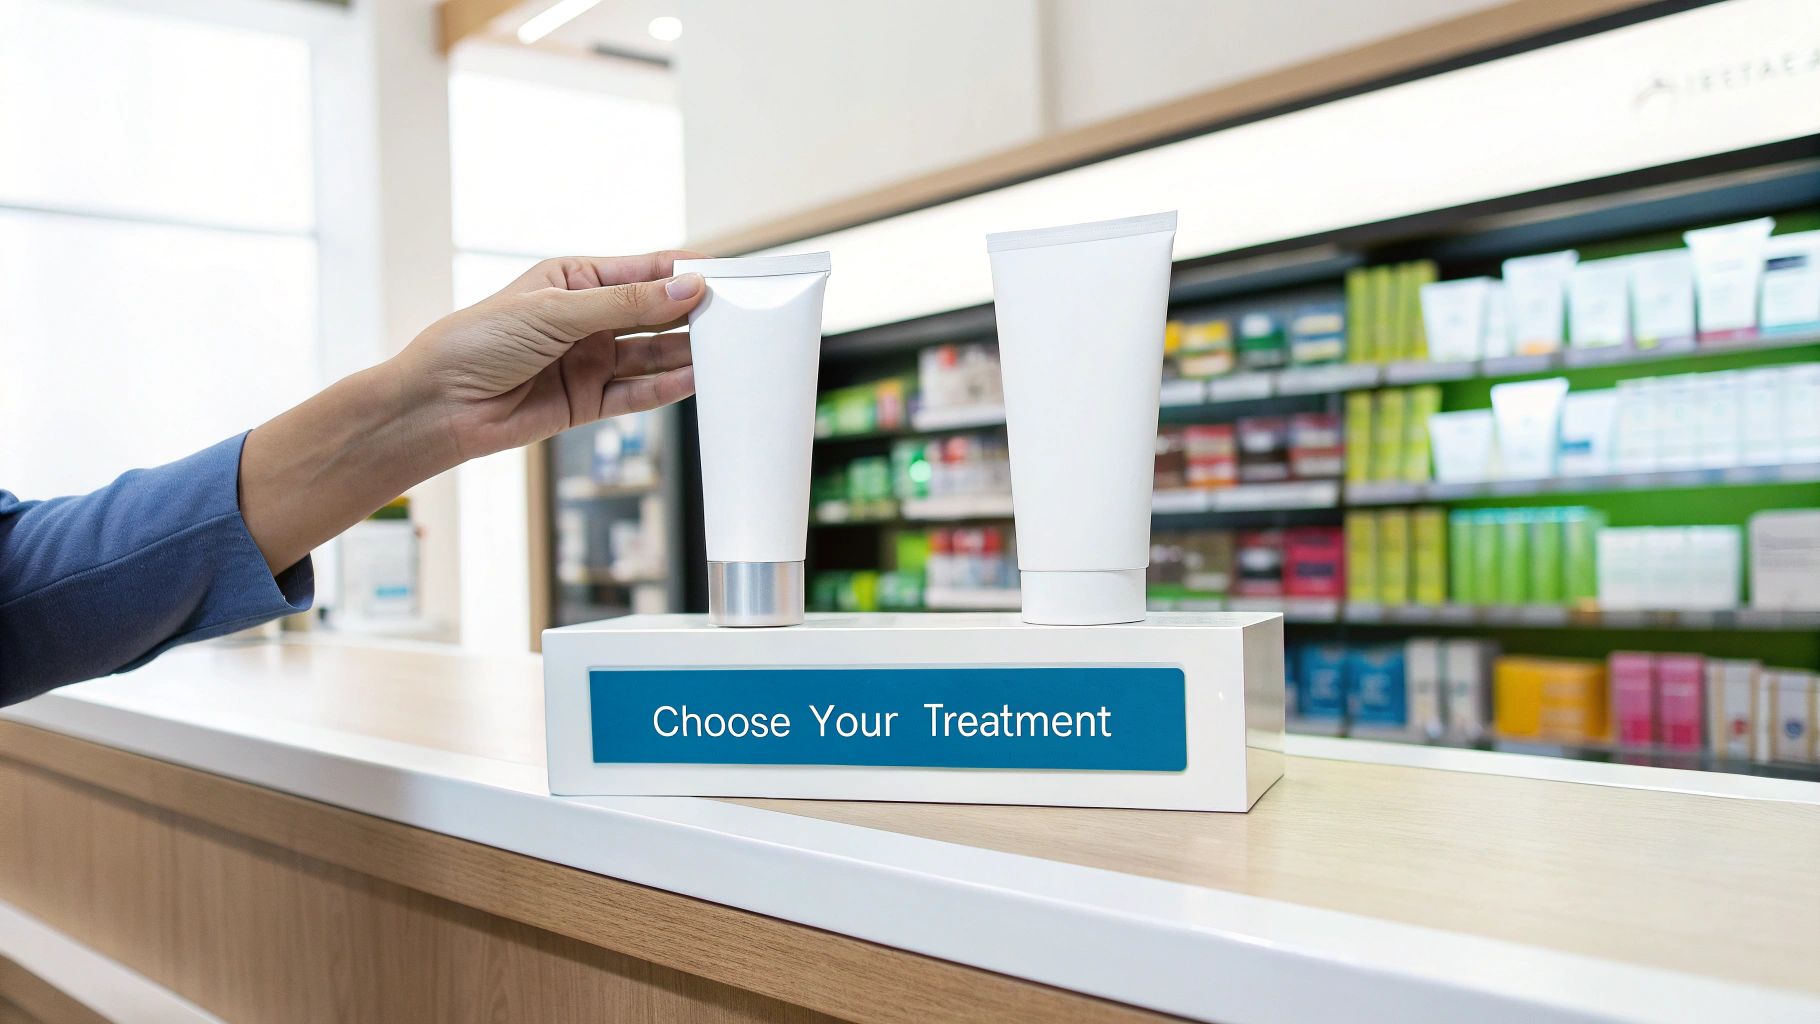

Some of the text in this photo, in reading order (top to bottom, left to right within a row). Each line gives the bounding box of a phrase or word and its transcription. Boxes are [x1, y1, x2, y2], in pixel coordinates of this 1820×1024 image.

[653, 703, 1112, 738] Choose Your Treatment
